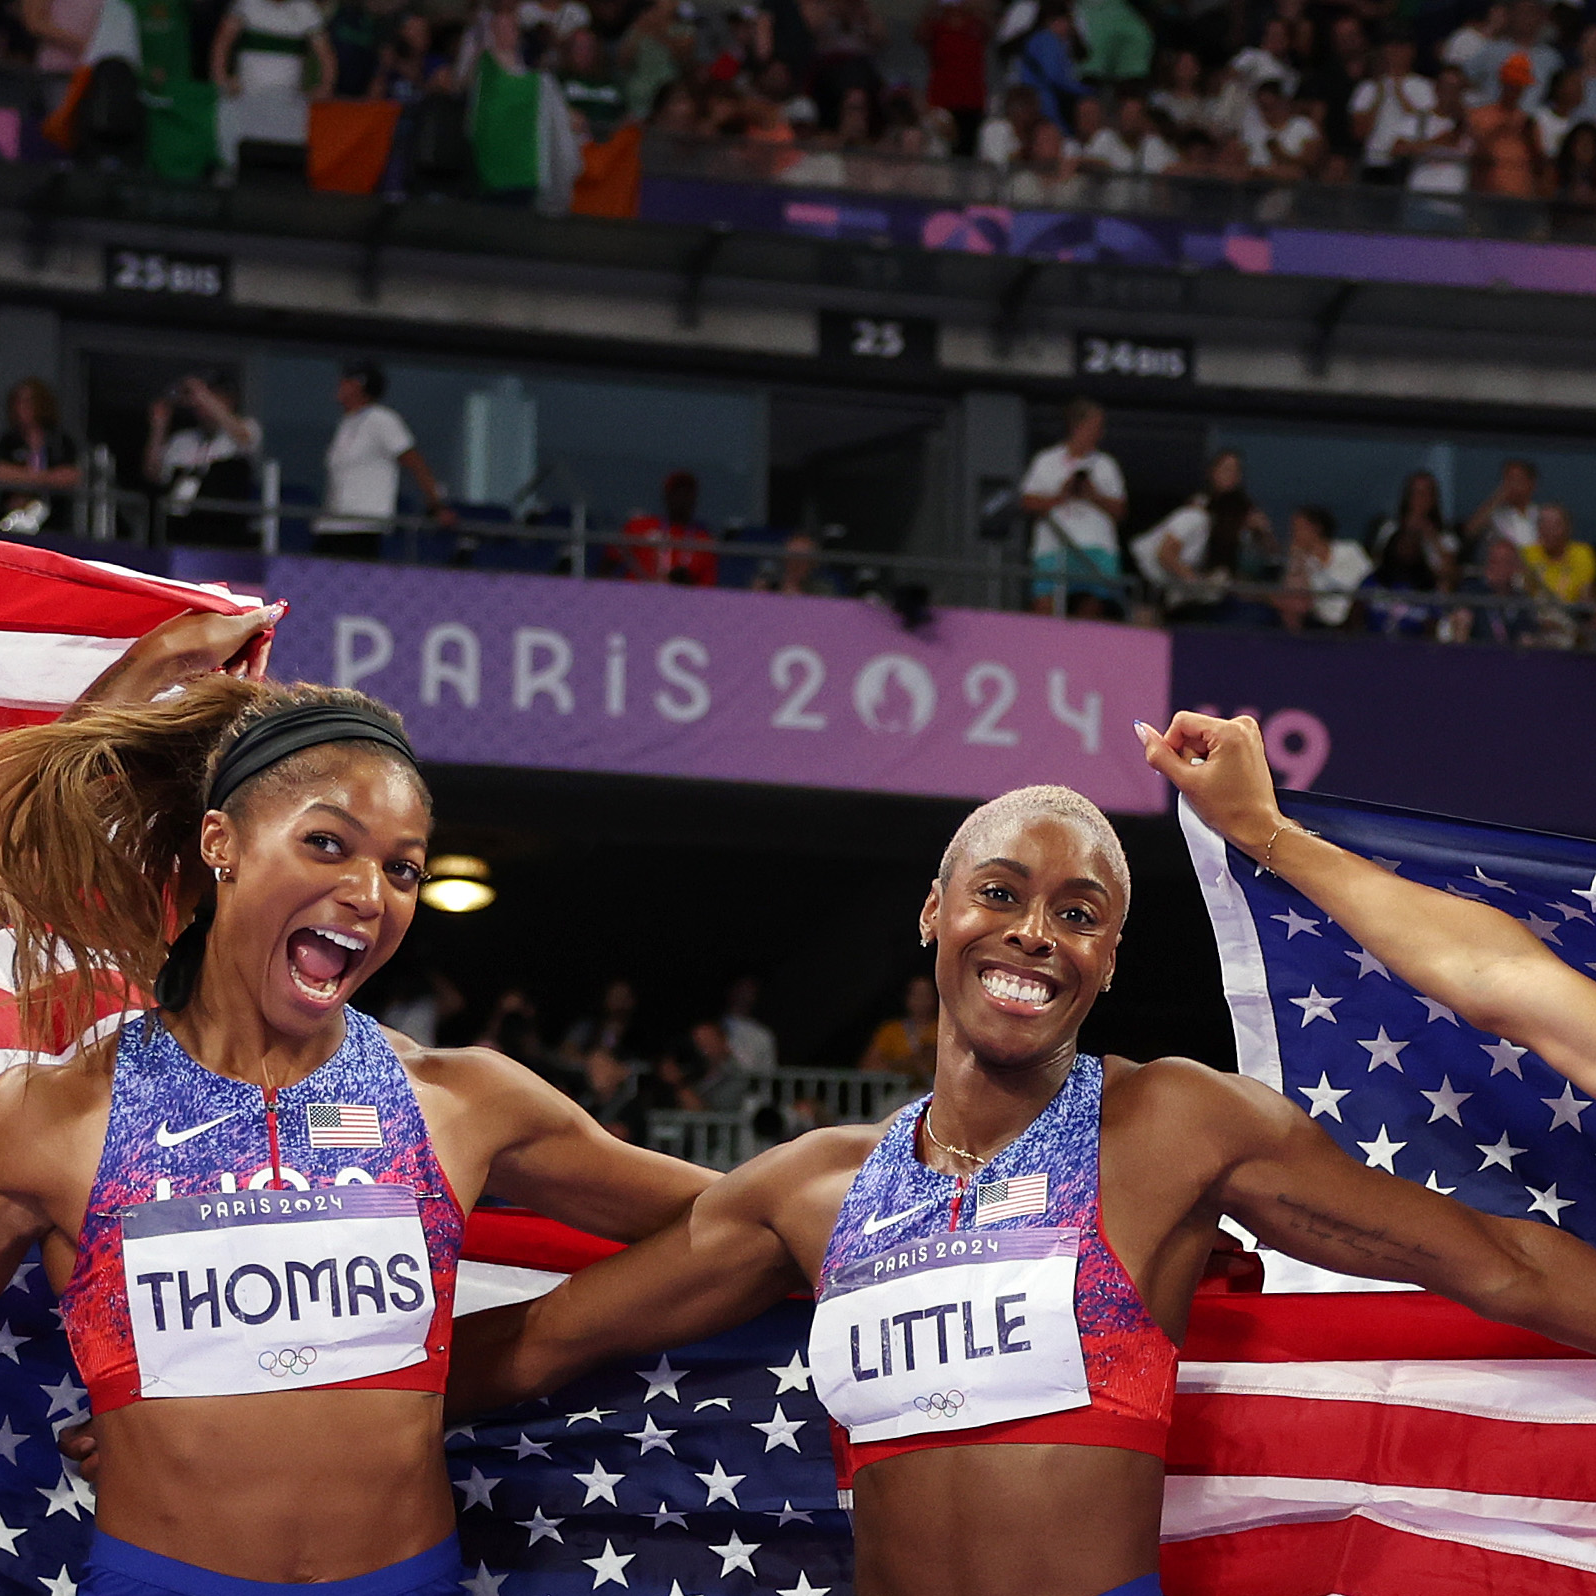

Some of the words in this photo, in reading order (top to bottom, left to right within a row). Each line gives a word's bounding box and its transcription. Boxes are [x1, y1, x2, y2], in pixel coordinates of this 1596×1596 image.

[851, 319, 904, 358] 25
[769, 643, 1104, 754] 2024
[279, 1194, 343, 1214] 2024
[935, 1238, 999, 1259] 2024
[136, 1253, 425, 1332] THOMAS
[850, 1292, 1032, 1383] LITTLE
